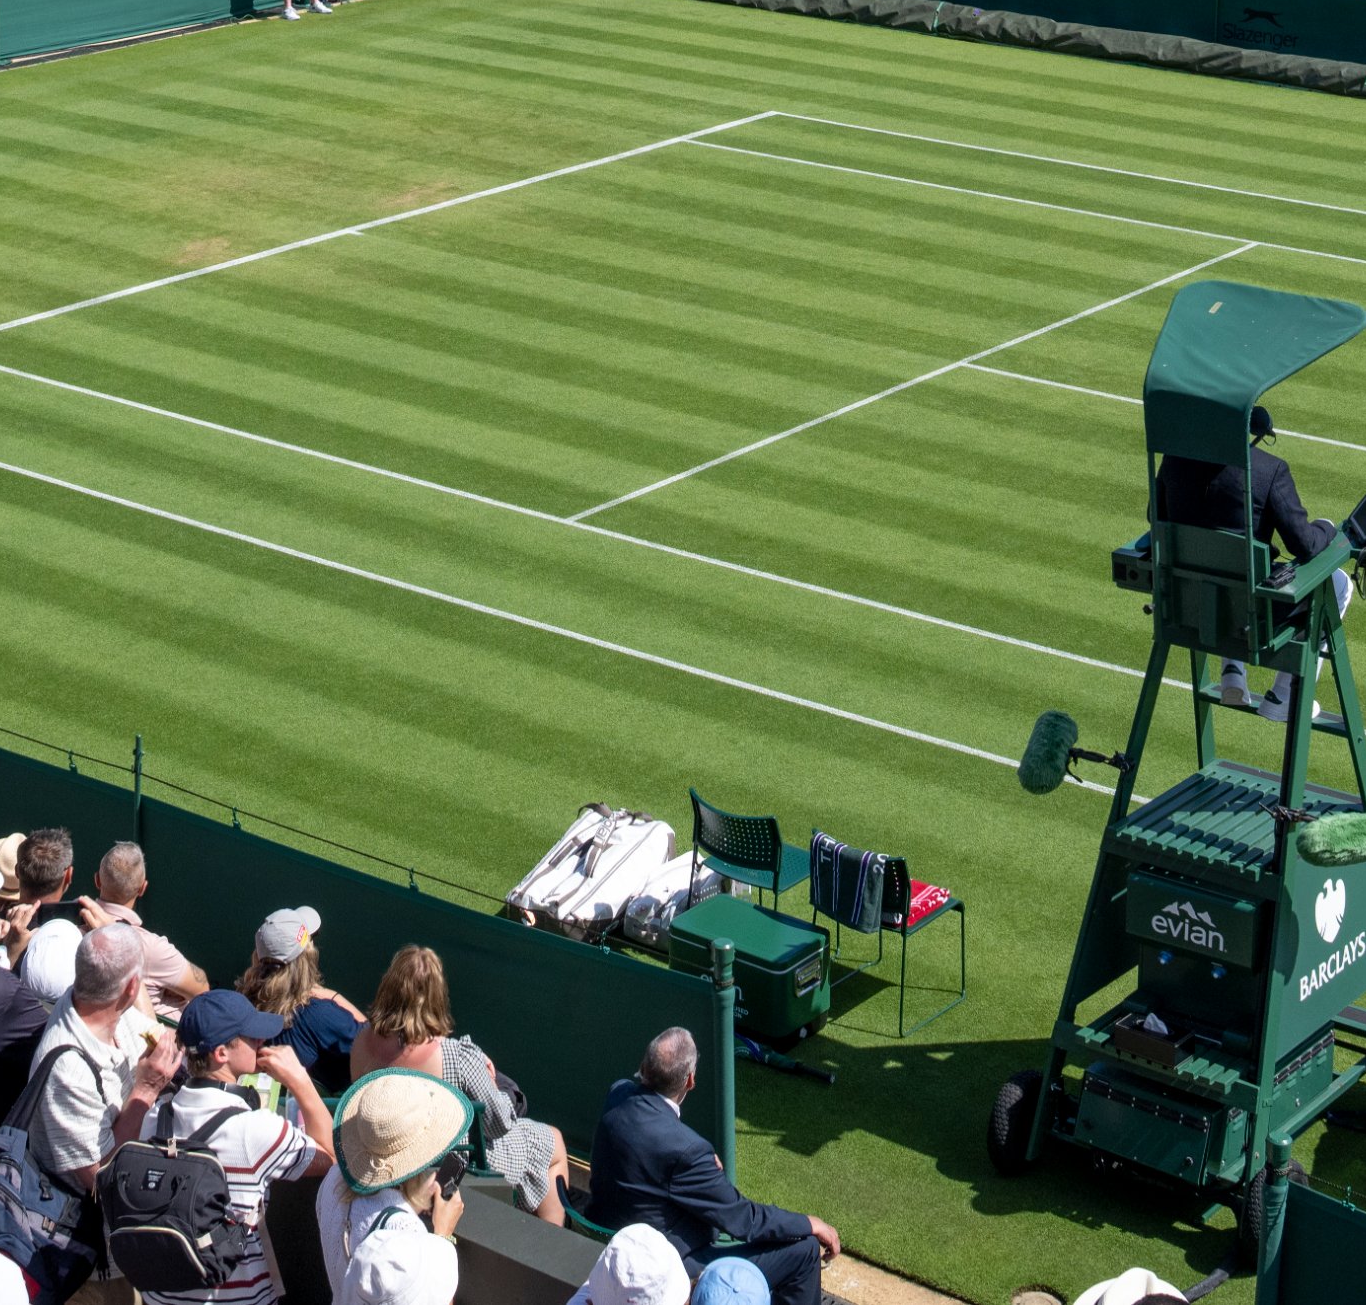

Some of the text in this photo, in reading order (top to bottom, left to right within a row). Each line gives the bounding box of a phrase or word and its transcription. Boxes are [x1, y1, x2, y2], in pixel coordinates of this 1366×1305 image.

[1223, 22, 1299, 50] Slazenger
[1151, 915, 1224, 952] evian
[1300, 931, 1366, 1002] BARCLAYS
